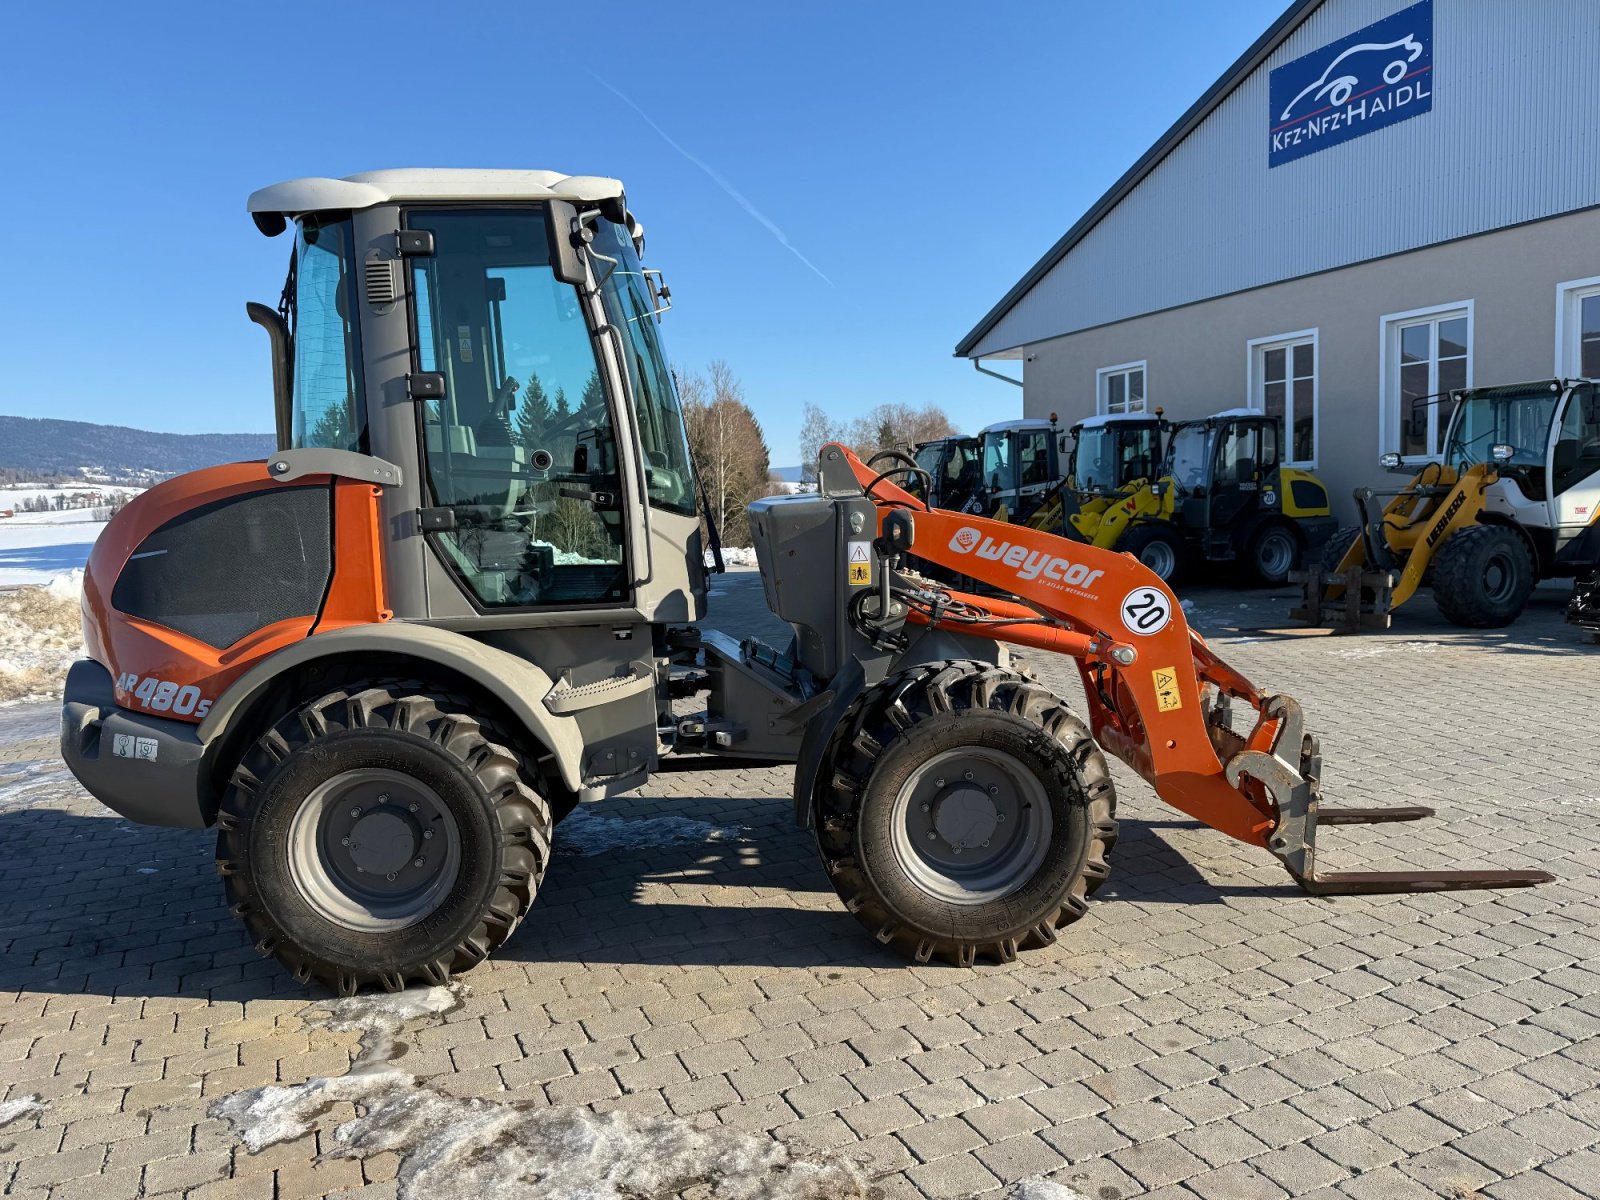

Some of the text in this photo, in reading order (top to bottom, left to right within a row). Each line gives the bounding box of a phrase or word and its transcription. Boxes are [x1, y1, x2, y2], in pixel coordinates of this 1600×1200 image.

[1273, 81, 1431, 153] KFZ-NFZ-HAIDL
[961, 494, 977, 514] EREX
[1426, 490, 1467, 548] LIEBHERR
[975, 536, 1104, 588] weycor
[1126, 593, 1165, 630] 20
[115, 672, 139, 693] AR
